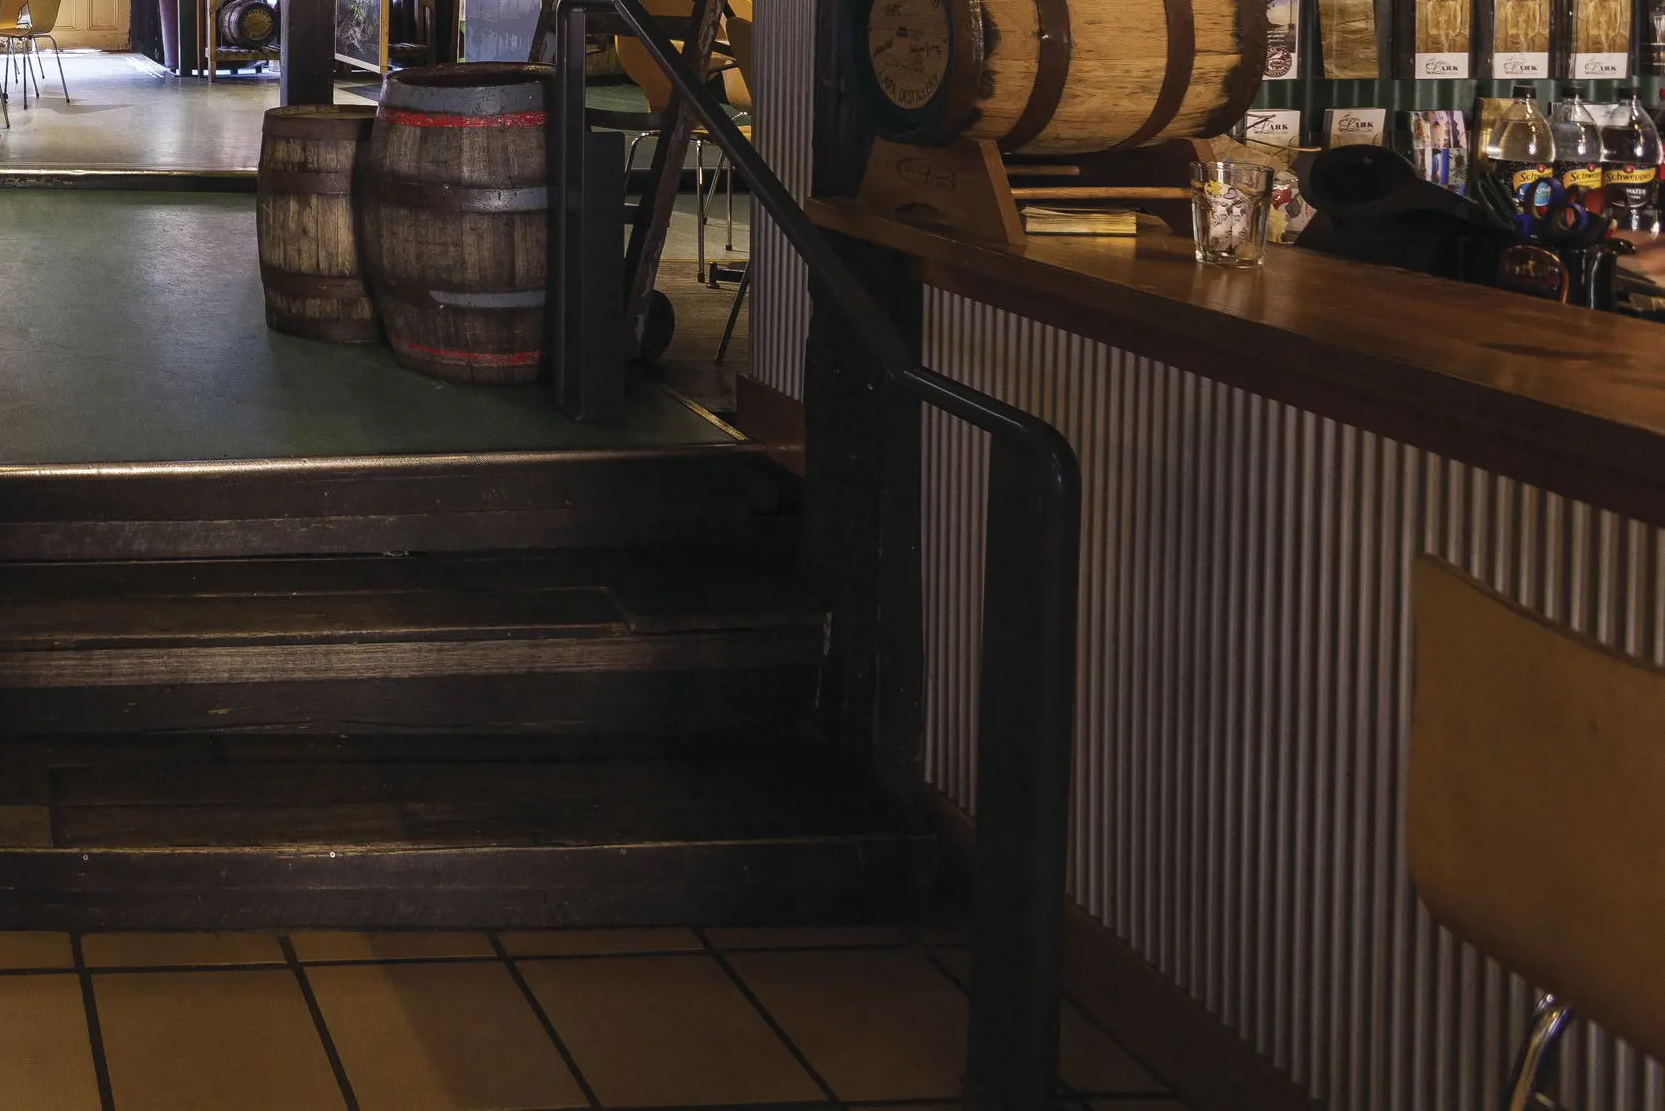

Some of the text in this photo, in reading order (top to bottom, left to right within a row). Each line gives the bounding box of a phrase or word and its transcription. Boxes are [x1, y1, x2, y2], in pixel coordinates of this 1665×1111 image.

[1425, 59, 1458, 73] LARK
[1503, 59, 1537, 73] LARK
[1584, 59, 1617, 73] LARK
[899, 74, 939, 103] DISTILLERY
[1254, 120, 1288, 134] LARK
[1338, 117, 1374, 131] LARK
[1606, 169, 1652, 183] Schweppes
